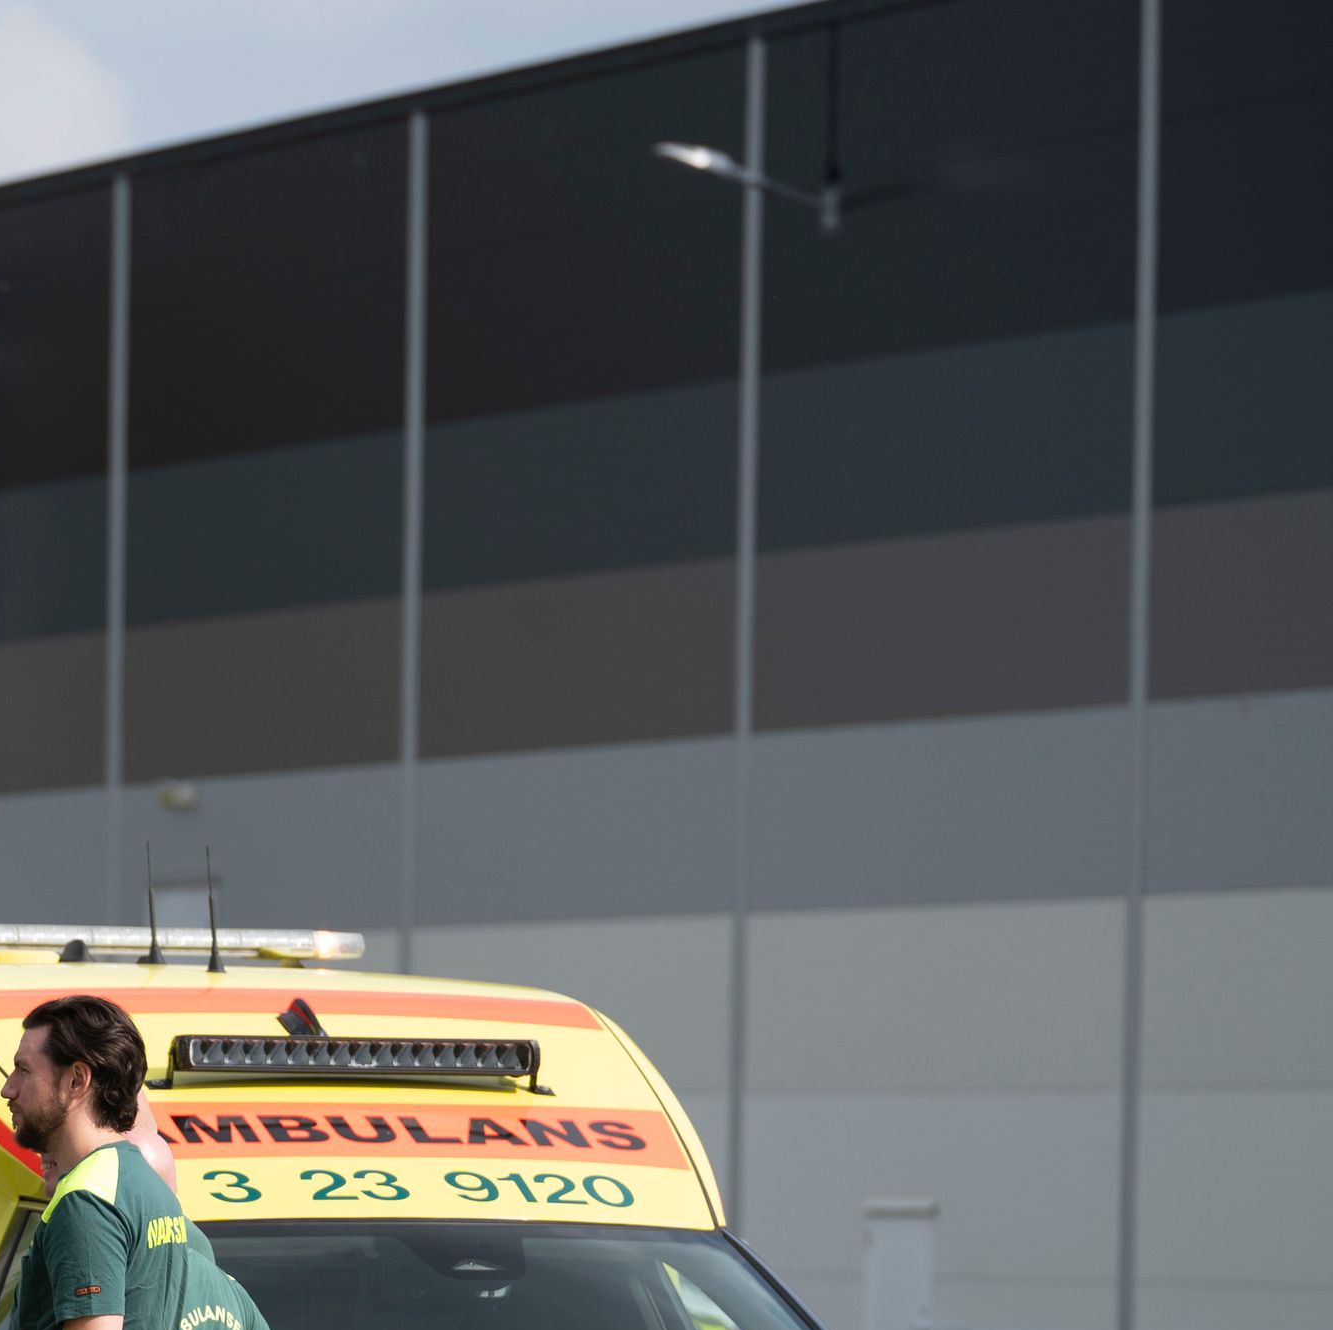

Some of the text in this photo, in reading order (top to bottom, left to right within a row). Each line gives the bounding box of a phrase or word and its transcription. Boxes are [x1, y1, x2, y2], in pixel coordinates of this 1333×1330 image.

[203, 1169, 635, 1208] 3 23 9120
